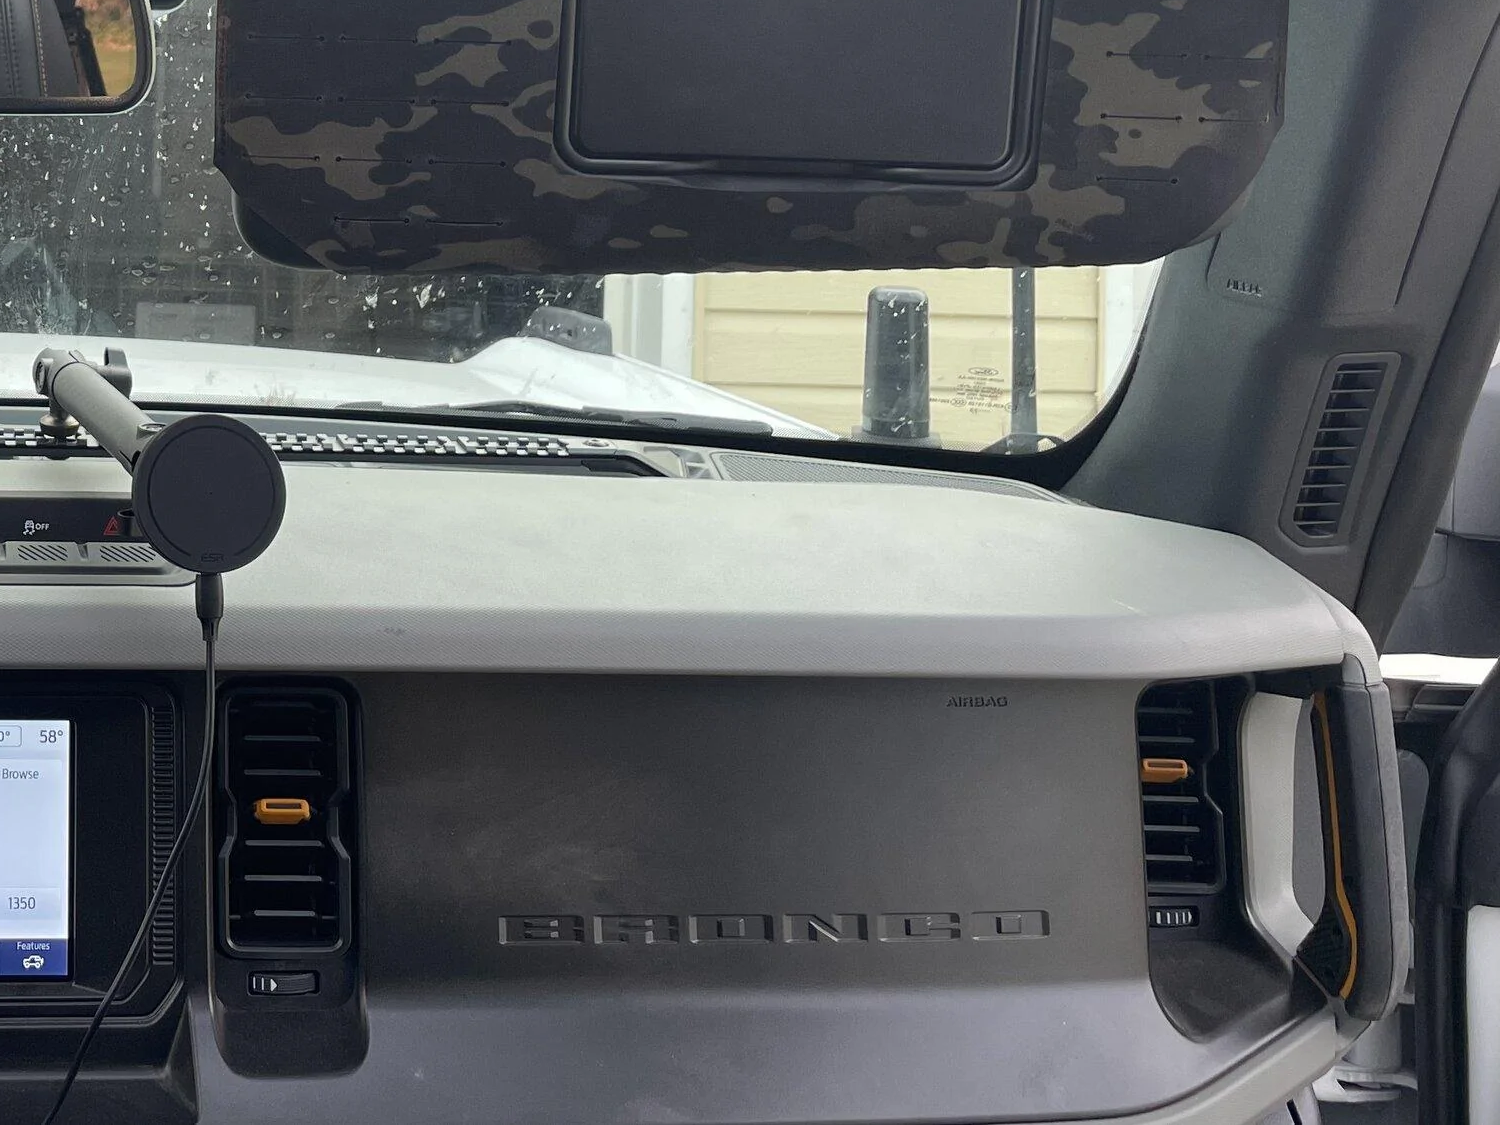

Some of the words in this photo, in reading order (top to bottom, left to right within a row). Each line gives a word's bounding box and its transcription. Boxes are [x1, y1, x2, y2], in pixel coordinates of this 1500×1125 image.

[35, 522, 50, 530] OFF
[946, 696, 1009, 708] AIRBAG
[39, 729, 64, 744] 58°
[1, 768, 39, 780] Browse
[7, 897, 36, 911] 1350
[499, 909, 1050, 945] BRONCO
[16, 941, 51, 952] Features
